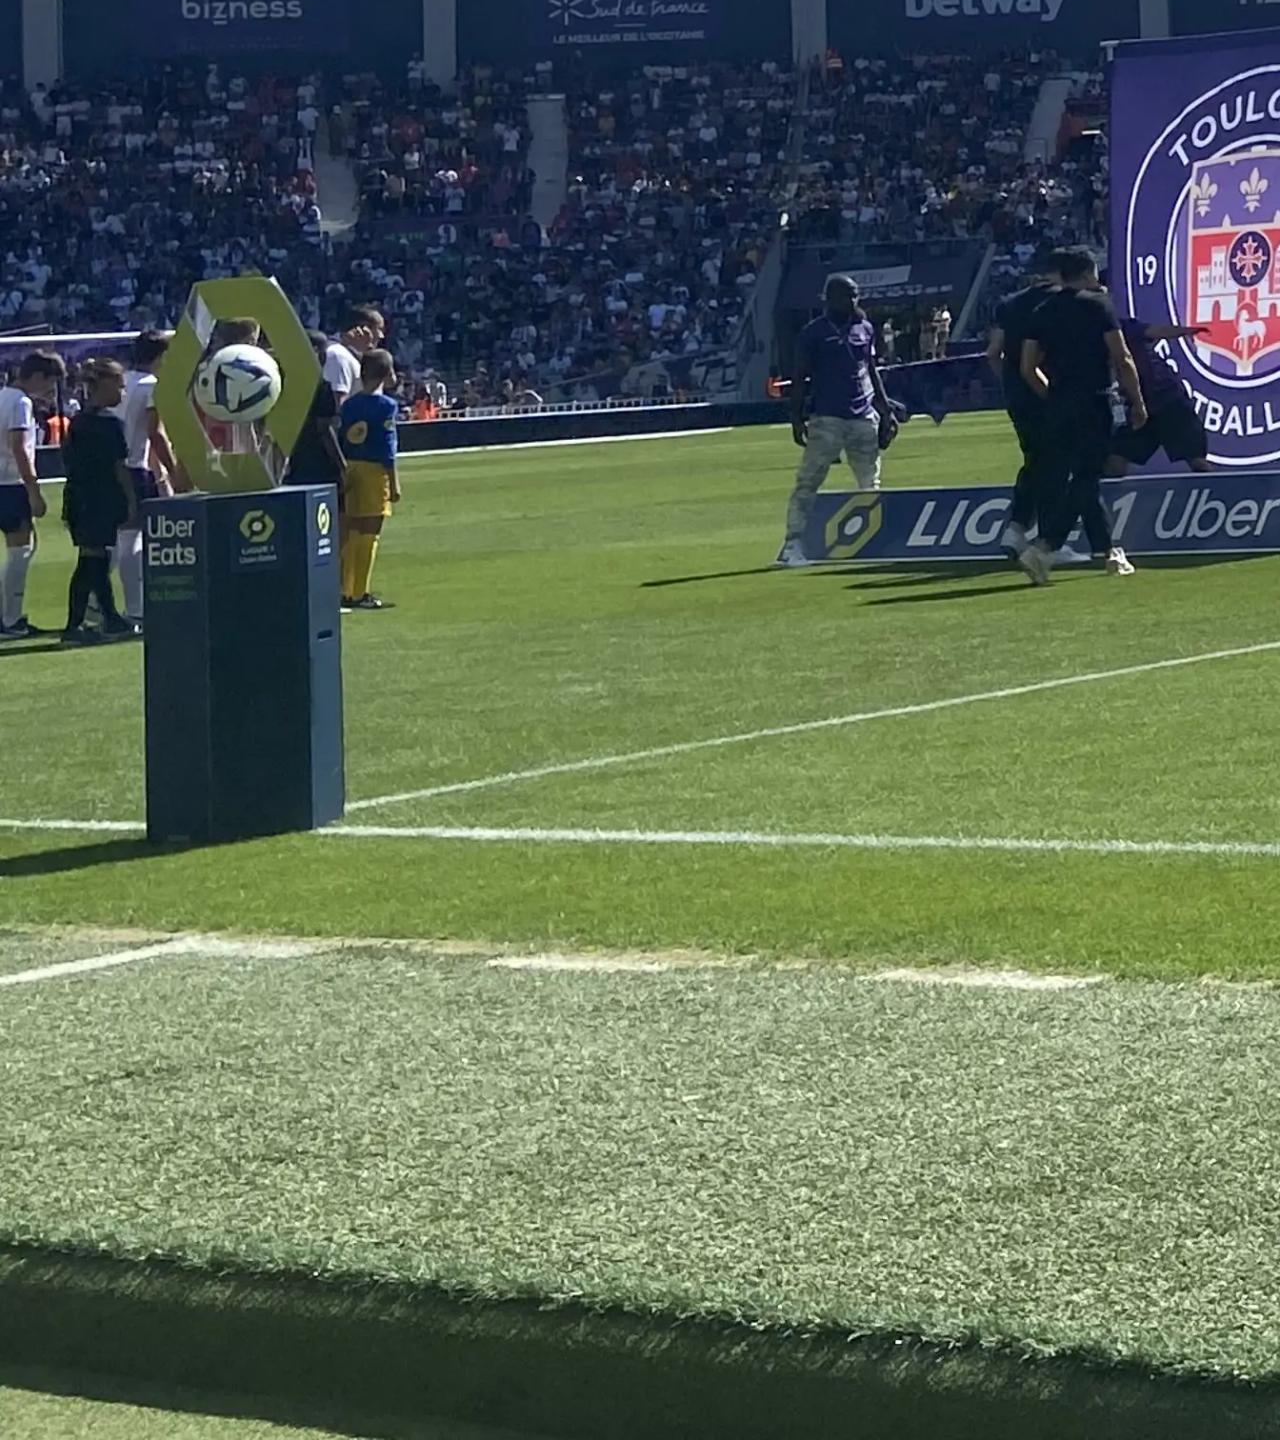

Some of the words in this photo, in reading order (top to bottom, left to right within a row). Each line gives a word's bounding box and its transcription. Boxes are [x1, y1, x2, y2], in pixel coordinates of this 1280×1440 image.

[625, 0, 646, 17] de
[1136, 255, 1158, 286] 19
[147, 514, 196, 539] Uber
[1110, 491, 1138, 541] 1
[1154, 488, 1278, 540] Uber
[148, 542, 197, 567] Eats
